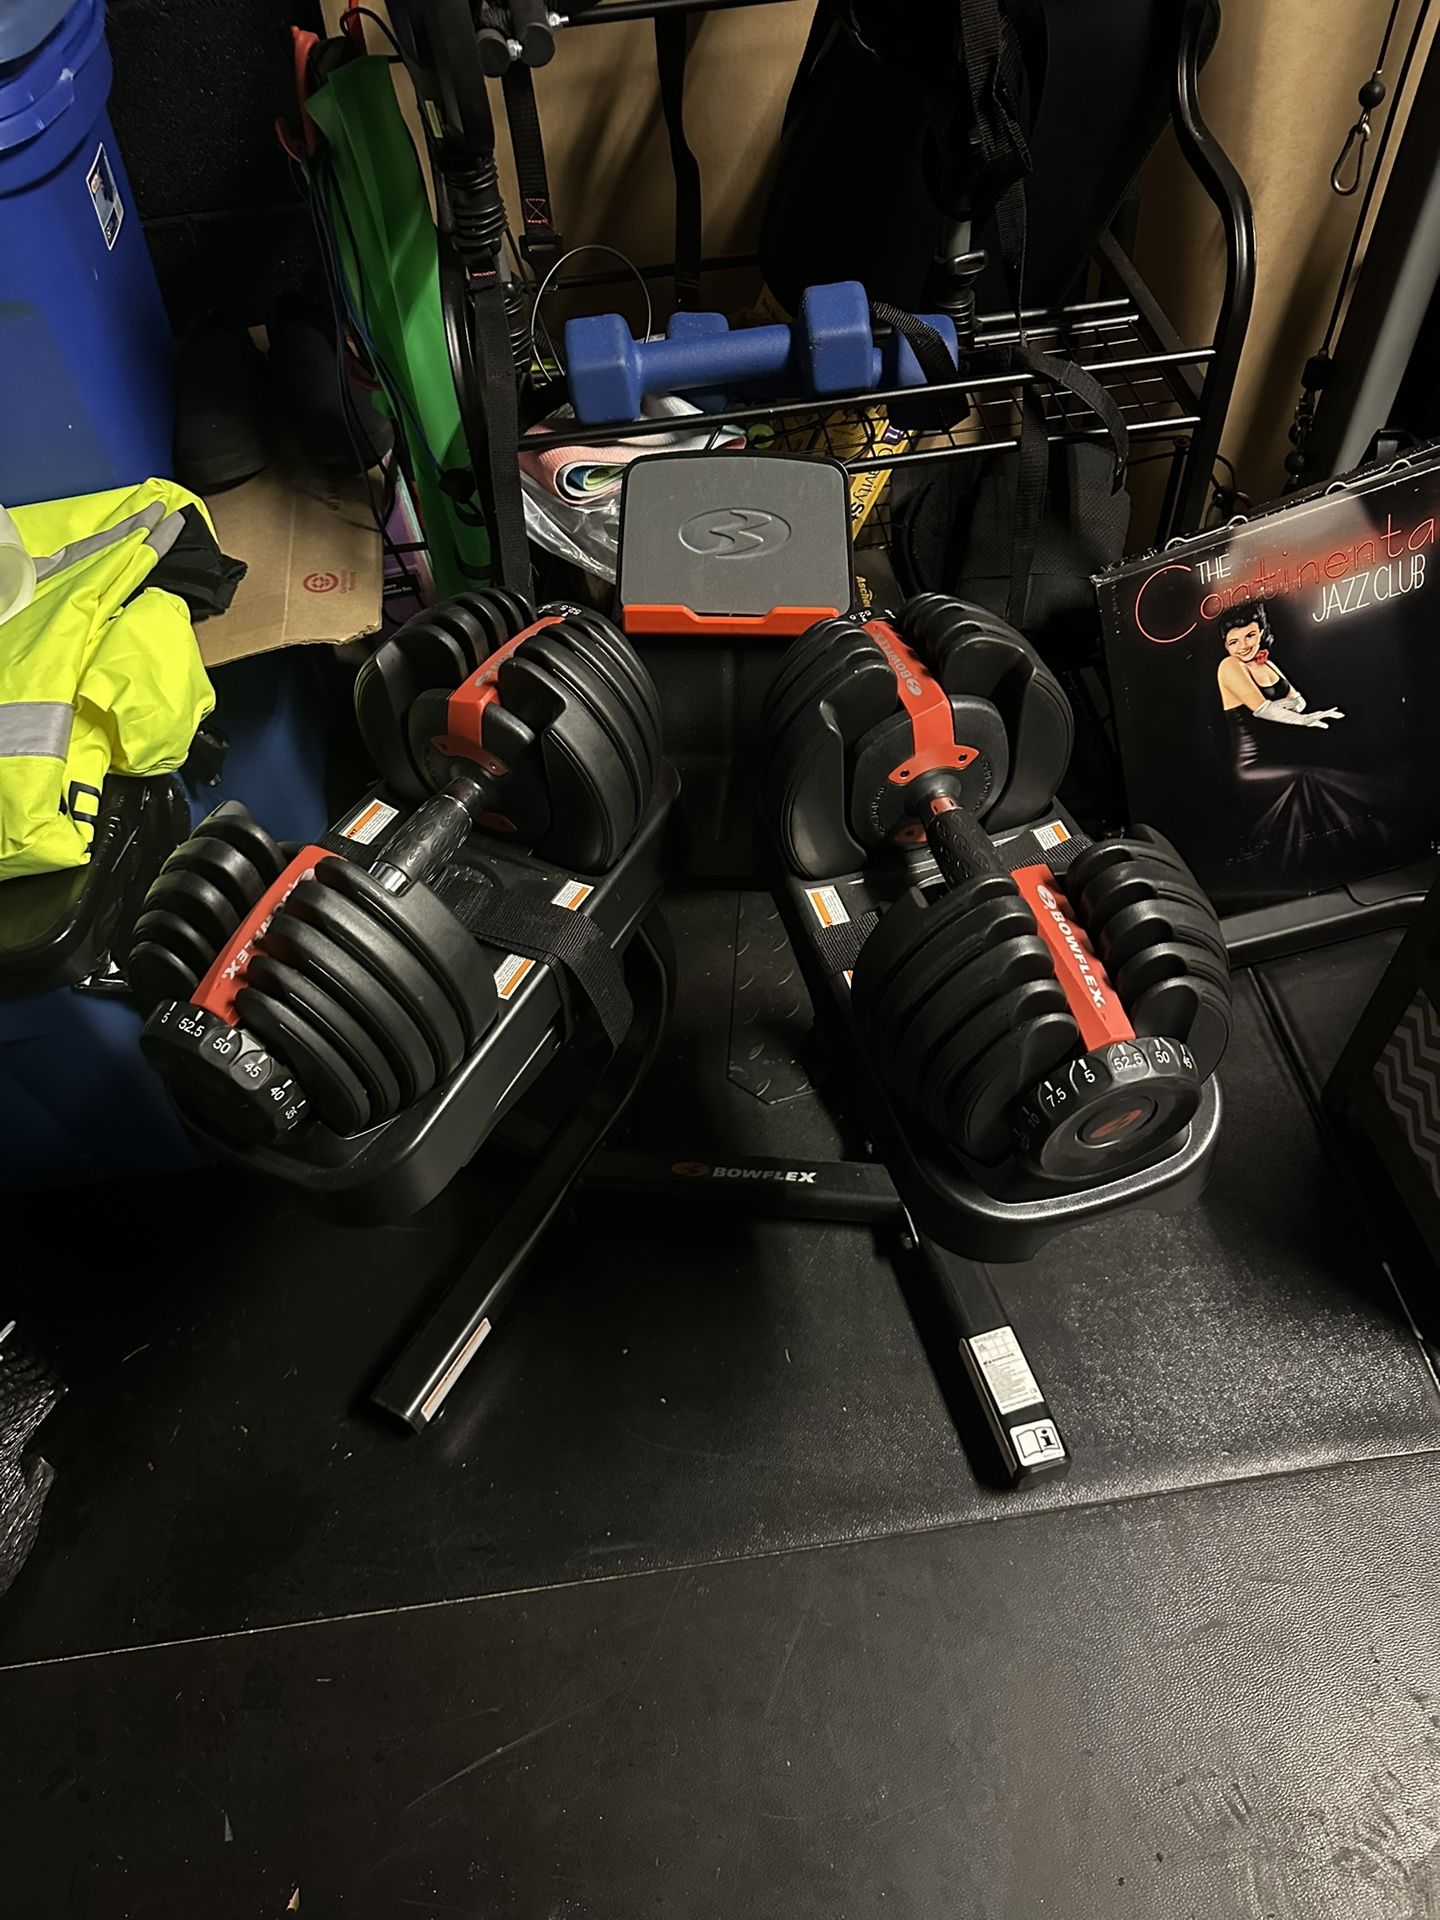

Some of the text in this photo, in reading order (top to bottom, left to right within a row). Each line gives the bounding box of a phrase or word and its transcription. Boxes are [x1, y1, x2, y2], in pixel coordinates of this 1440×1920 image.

[1135, 513, 1440, 643] Continenta
[1196, 554, 1231, 585] THE
[1312, 553, 1426, 623] JAZZ CLUB
[1050, 911, 1106, 1009] BOWFLEX
[161, 1012, 171, 1023] 5
[178, 1017, 205, 1037] 52.5
[212, 1037, 231, 1054] 50
[244, 1062, 262, 1078] 45
[270, 1086, 285, 1101] 40
[1046, 1087, 1067, 1108] 7.5
[1084, 1070, 1096, 1083] 5
[1113, 1052, 1144, 1071] 52.5
[1155, 1051, 1170, 1064] 50
[712, 1166, 817, 1184] BOWFLEX
